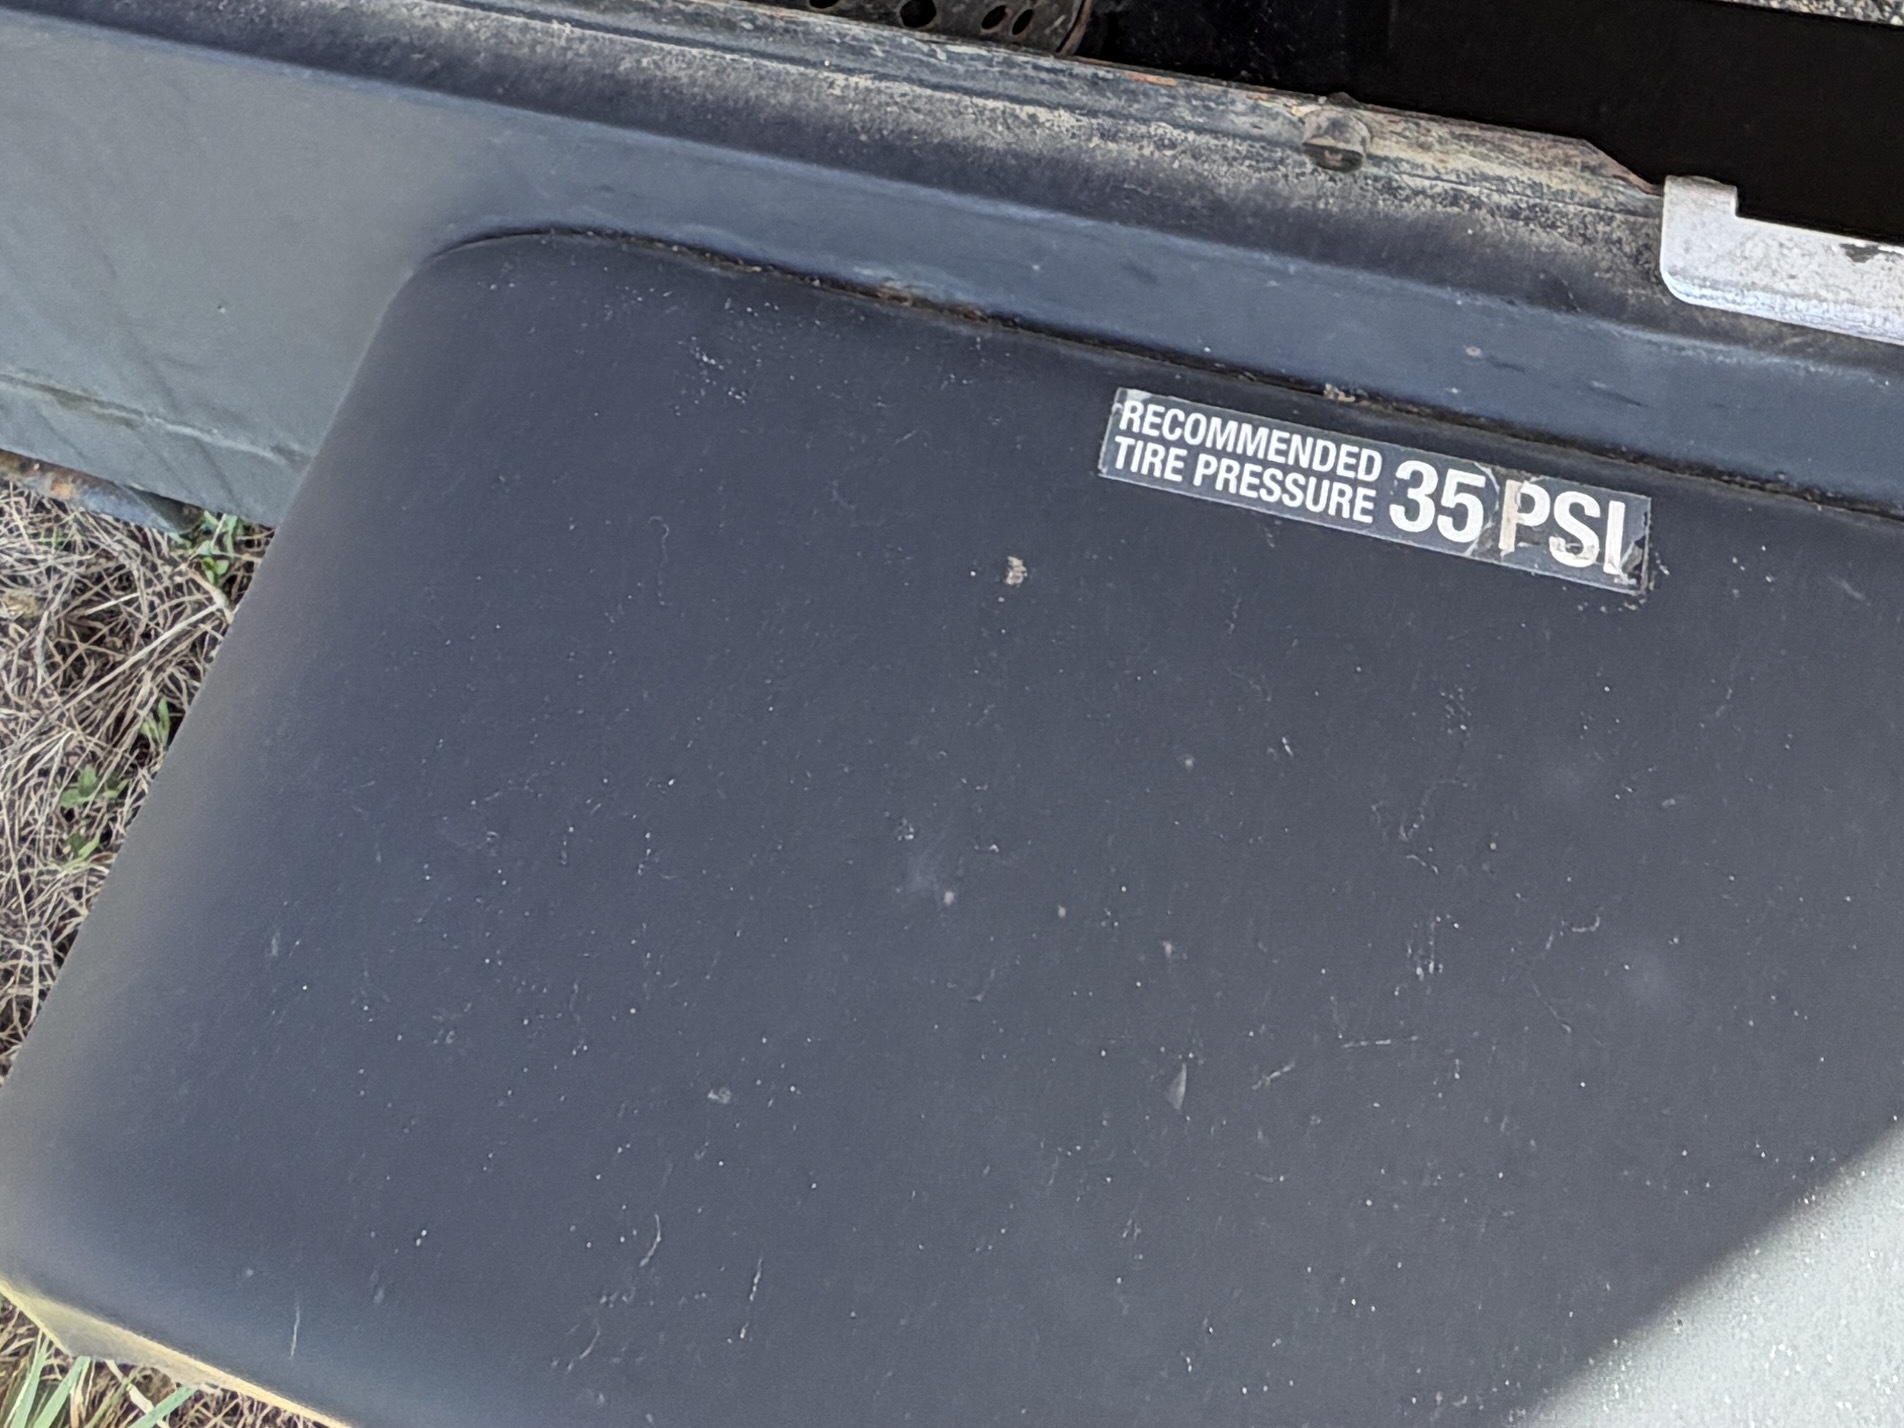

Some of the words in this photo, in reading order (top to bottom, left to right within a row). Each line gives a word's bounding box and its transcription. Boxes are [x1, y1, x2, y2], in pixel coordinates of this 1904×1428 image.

[1114, 435, 1188, 482] TIRE
[1192, 453, 1377, 524] PRESSURE
[1118, 400, 1383, 482] RECOMMENDED
[1388, 459, 1487, 543] 35
[1498, 479, 1627, 576] PSI
